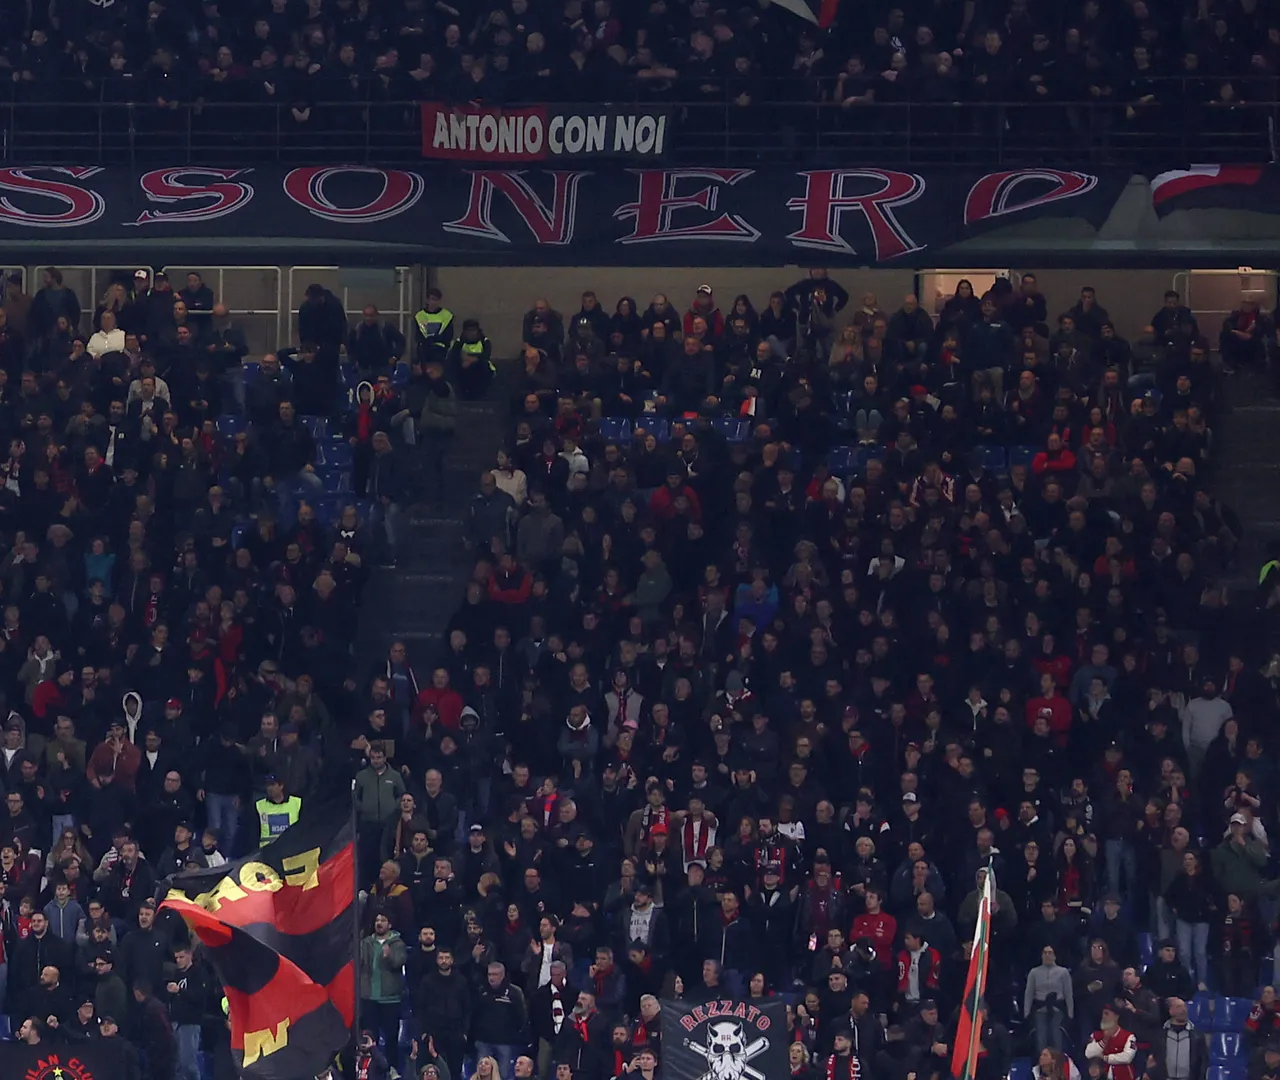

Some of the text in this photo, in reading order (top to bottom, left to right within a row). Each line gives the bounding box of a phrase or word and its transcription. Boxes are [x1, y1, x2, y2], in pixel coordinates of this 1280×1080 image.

[432, 111, 667, 154] ANTONIO CON NOI
[680, 999, 771, 1032] REZZATO
[68, 1057, 95, 1080] CLU
